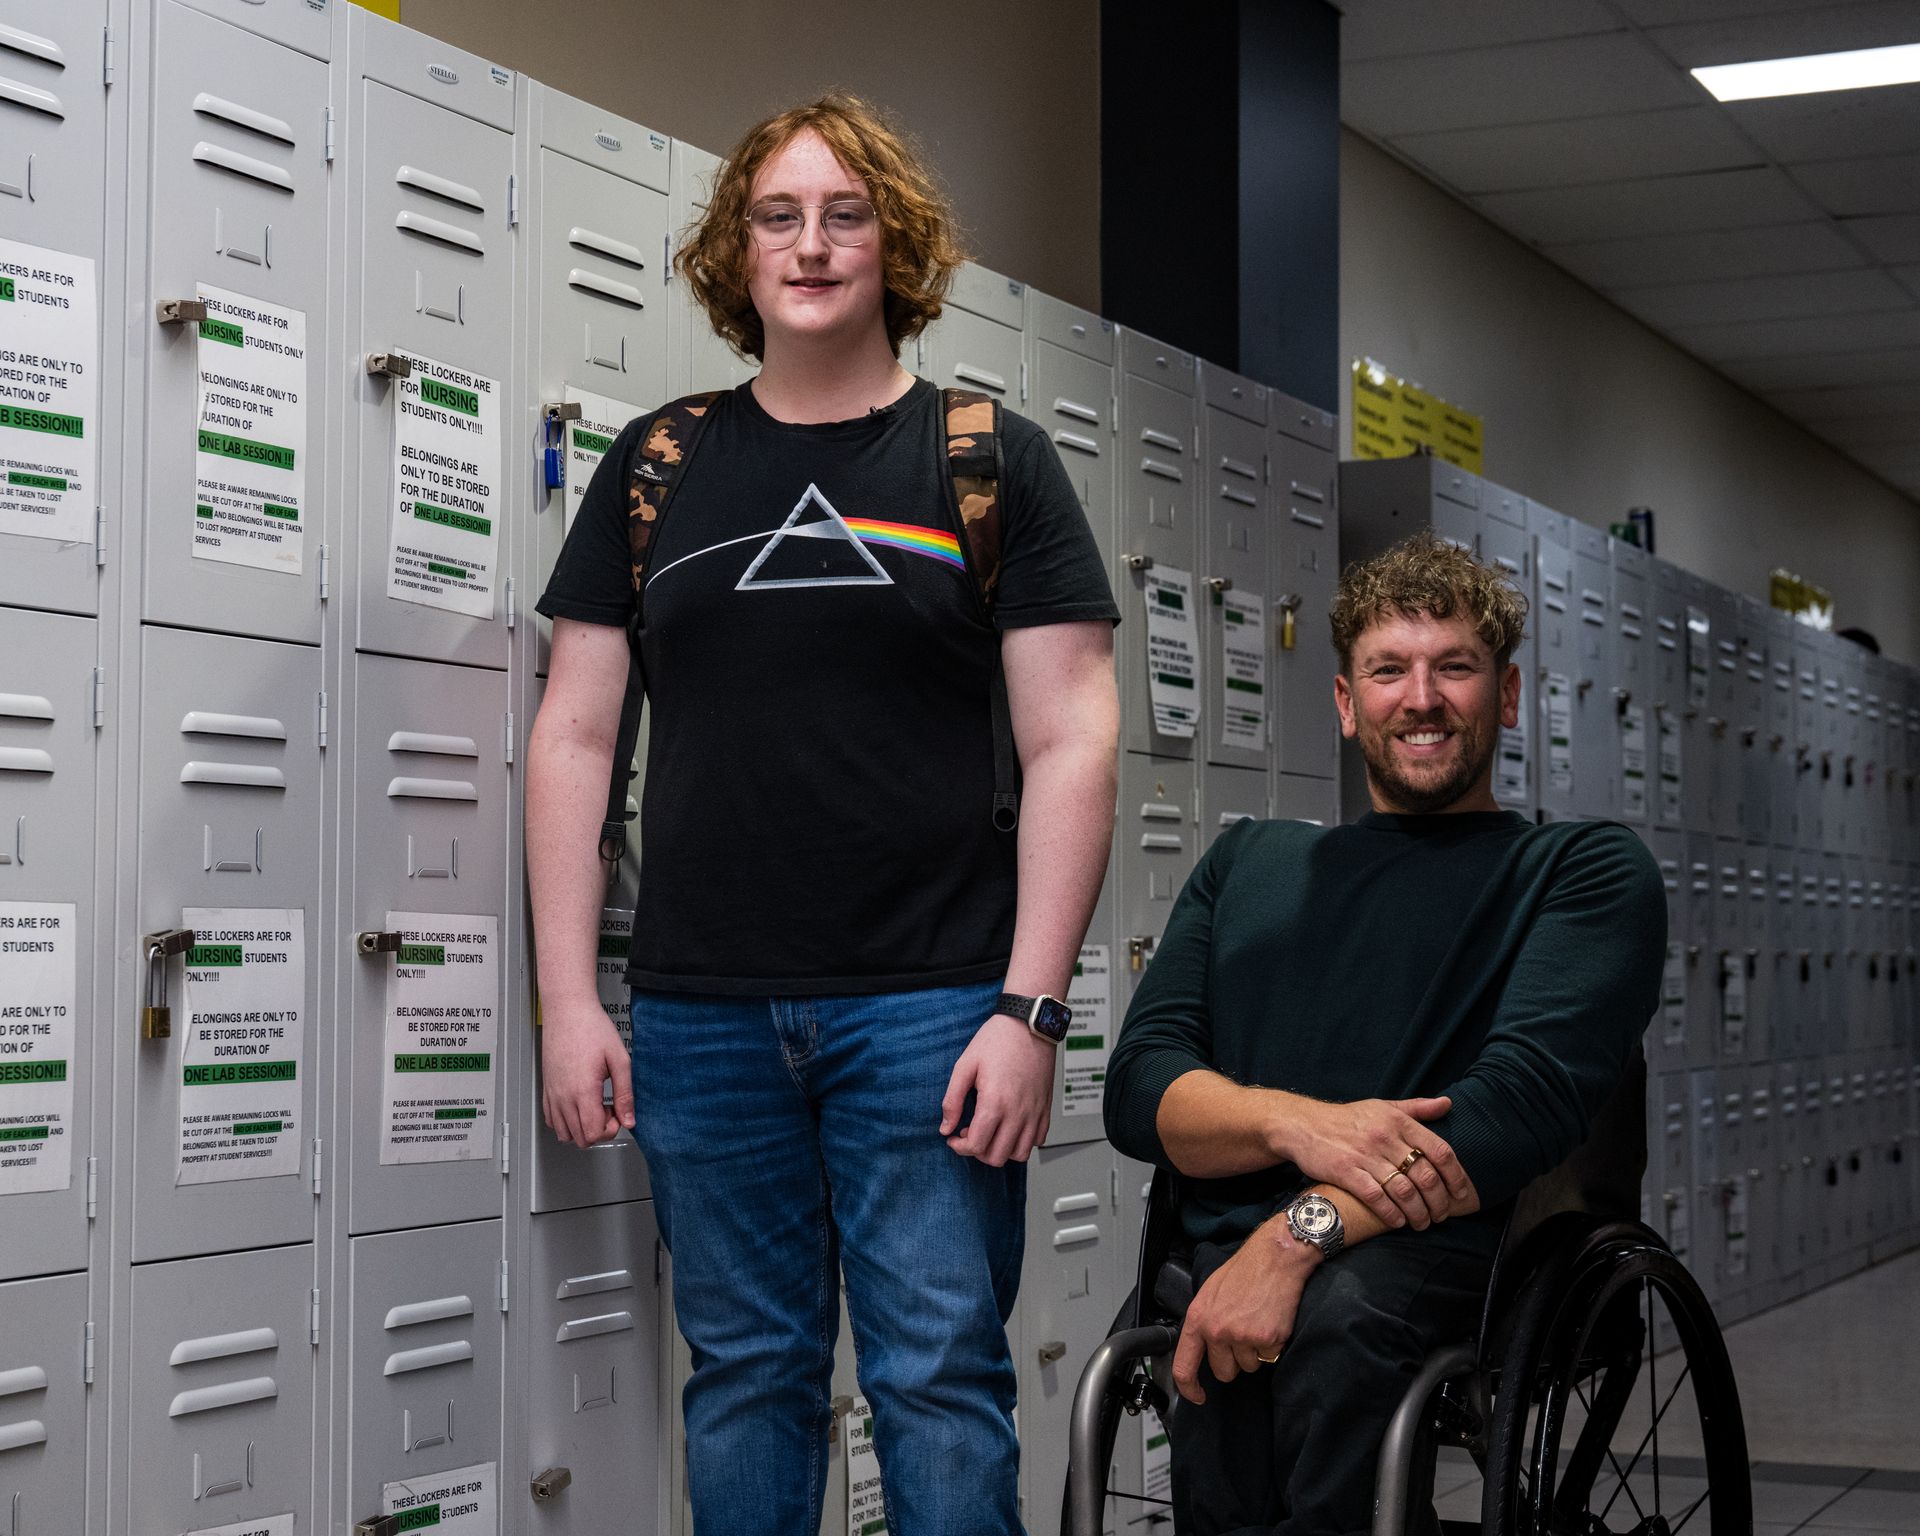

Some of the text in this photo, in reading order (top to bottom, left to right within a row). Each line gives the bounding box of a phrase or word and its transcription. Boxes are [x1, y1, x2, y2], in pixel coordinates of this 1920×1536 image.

[430, 66, 456, 80] STEELCO
[32, 269, 52, 282] ARE
[55, 274, 74, 287] FOR
[18, 290, 69, 308] STUDENTS
[224, 304, 255, 320] LOCKERS
[258, 313, 271, 324] ARE
[274, 317, 288, 329] FOR
[199, 322, 303, 359] NURSING STUDENTS ONLY
[18, 353, 38, 366] ARE
[42, 357, 68, 371] ONLY
[70, 362, 82, 374] TO
[26, 373, 67, 389] FOR THE
[432, 365, 471, 387] LOCKERS
[474, 377, 490, 393] ARE
[38, 392, 50, 403] OF
[251, 384, 264, 395] ARE
[267, 388, 286, 400] ONLY
[288, 392, 297, 403] TO
[401, 381, 478, 412] FOR NURSING
[211, 394, 273, 416] STORED FOR THE
[14, 411, 83, 434] SESSION!!!
[242, 420, 252, 430] OF
[401, 402, 482, 434] STUDENTS ONLY!!!!
[199, 435, 220, 451] ONE
[223, 440, 241, 455] LAB
[402, 446, 478, 475] BELONGINGS ARE
[401, 464, 489, 496] ONLY TO BE STORED
[16, 490, 35, 499] TAKEN
[38, 492, 45, 500] TO
[47, 494, 61, 502] LOST
[198, 479, 297, 505] PLEASE BE AWARE REMAINING LOCKS
[401, 483, 484, 513] FOR THE DURATION
[400, 502, 412, 514] OF
[415, 506, 431, 519] ONE
[434, 510, 448, 523] LAB
[197, 521, 204, 529] TO
[206, 523, 219, 532] LOST
[220, 526, 248, 537] PROPERTY
[258, 532, 282, 543] STUDENT
[195, 536, 221, 546] SERVICES
[17, 918, 59, 928] ARE FOR
[601, 920, 630, 931] OCKERS
[215, 931, 291, 941] LOCKERS ARE FOR
[422, 932, 455, 942] LOCKERS
[457, 934, 471, 943] ARE
[473, 934, 487, 944] FOR
[3, 942, 54, 952] STUDENTS
[186, 949, 287, 963] NURSING STUDENTS
[397, 948, 483, 963] NURSING STUDENTS
[397, 969, 425, 978] ONLY!!!!
[2, 1006, 66, 1018] ARE ONLY TO
[193, 1012, 297, 1024] ELONGINGS ARE ONLY TO
[397, 1007, 491, 1017] BELONGINGS ARE ONLY TO
[10, 1024, 50, 1035] FOR THE
[200, 1028, 283, 1040] BE STORED FOR THE
[408, 1023, 480, 1032] BE STORED FOR THE
[21, 1042, 33, 1052] OF
[420, 1038, 468, 1046] DURATION OF
[215, 1045, 270, 1056] DURATION OF
[395, 1056, 489, 1069] ONE LAB SESSION!!!
[184, 1064, 295, 1082] ONE LAB SESSION!!!
[28, 1143, 43, 1151] LOST
[183, 1141, 216, 1150] BELONGINGS
[851, 1428, 862, 1439] FOR
[392, 1481, 482, 1509] THESE LOCKERS ARE FOR
[853, 1492, 878, 1508] ONLY TO
[442, 1503, 478, 1519] STUDENTS
[852, 1508, 877, 1523] FOR THE
